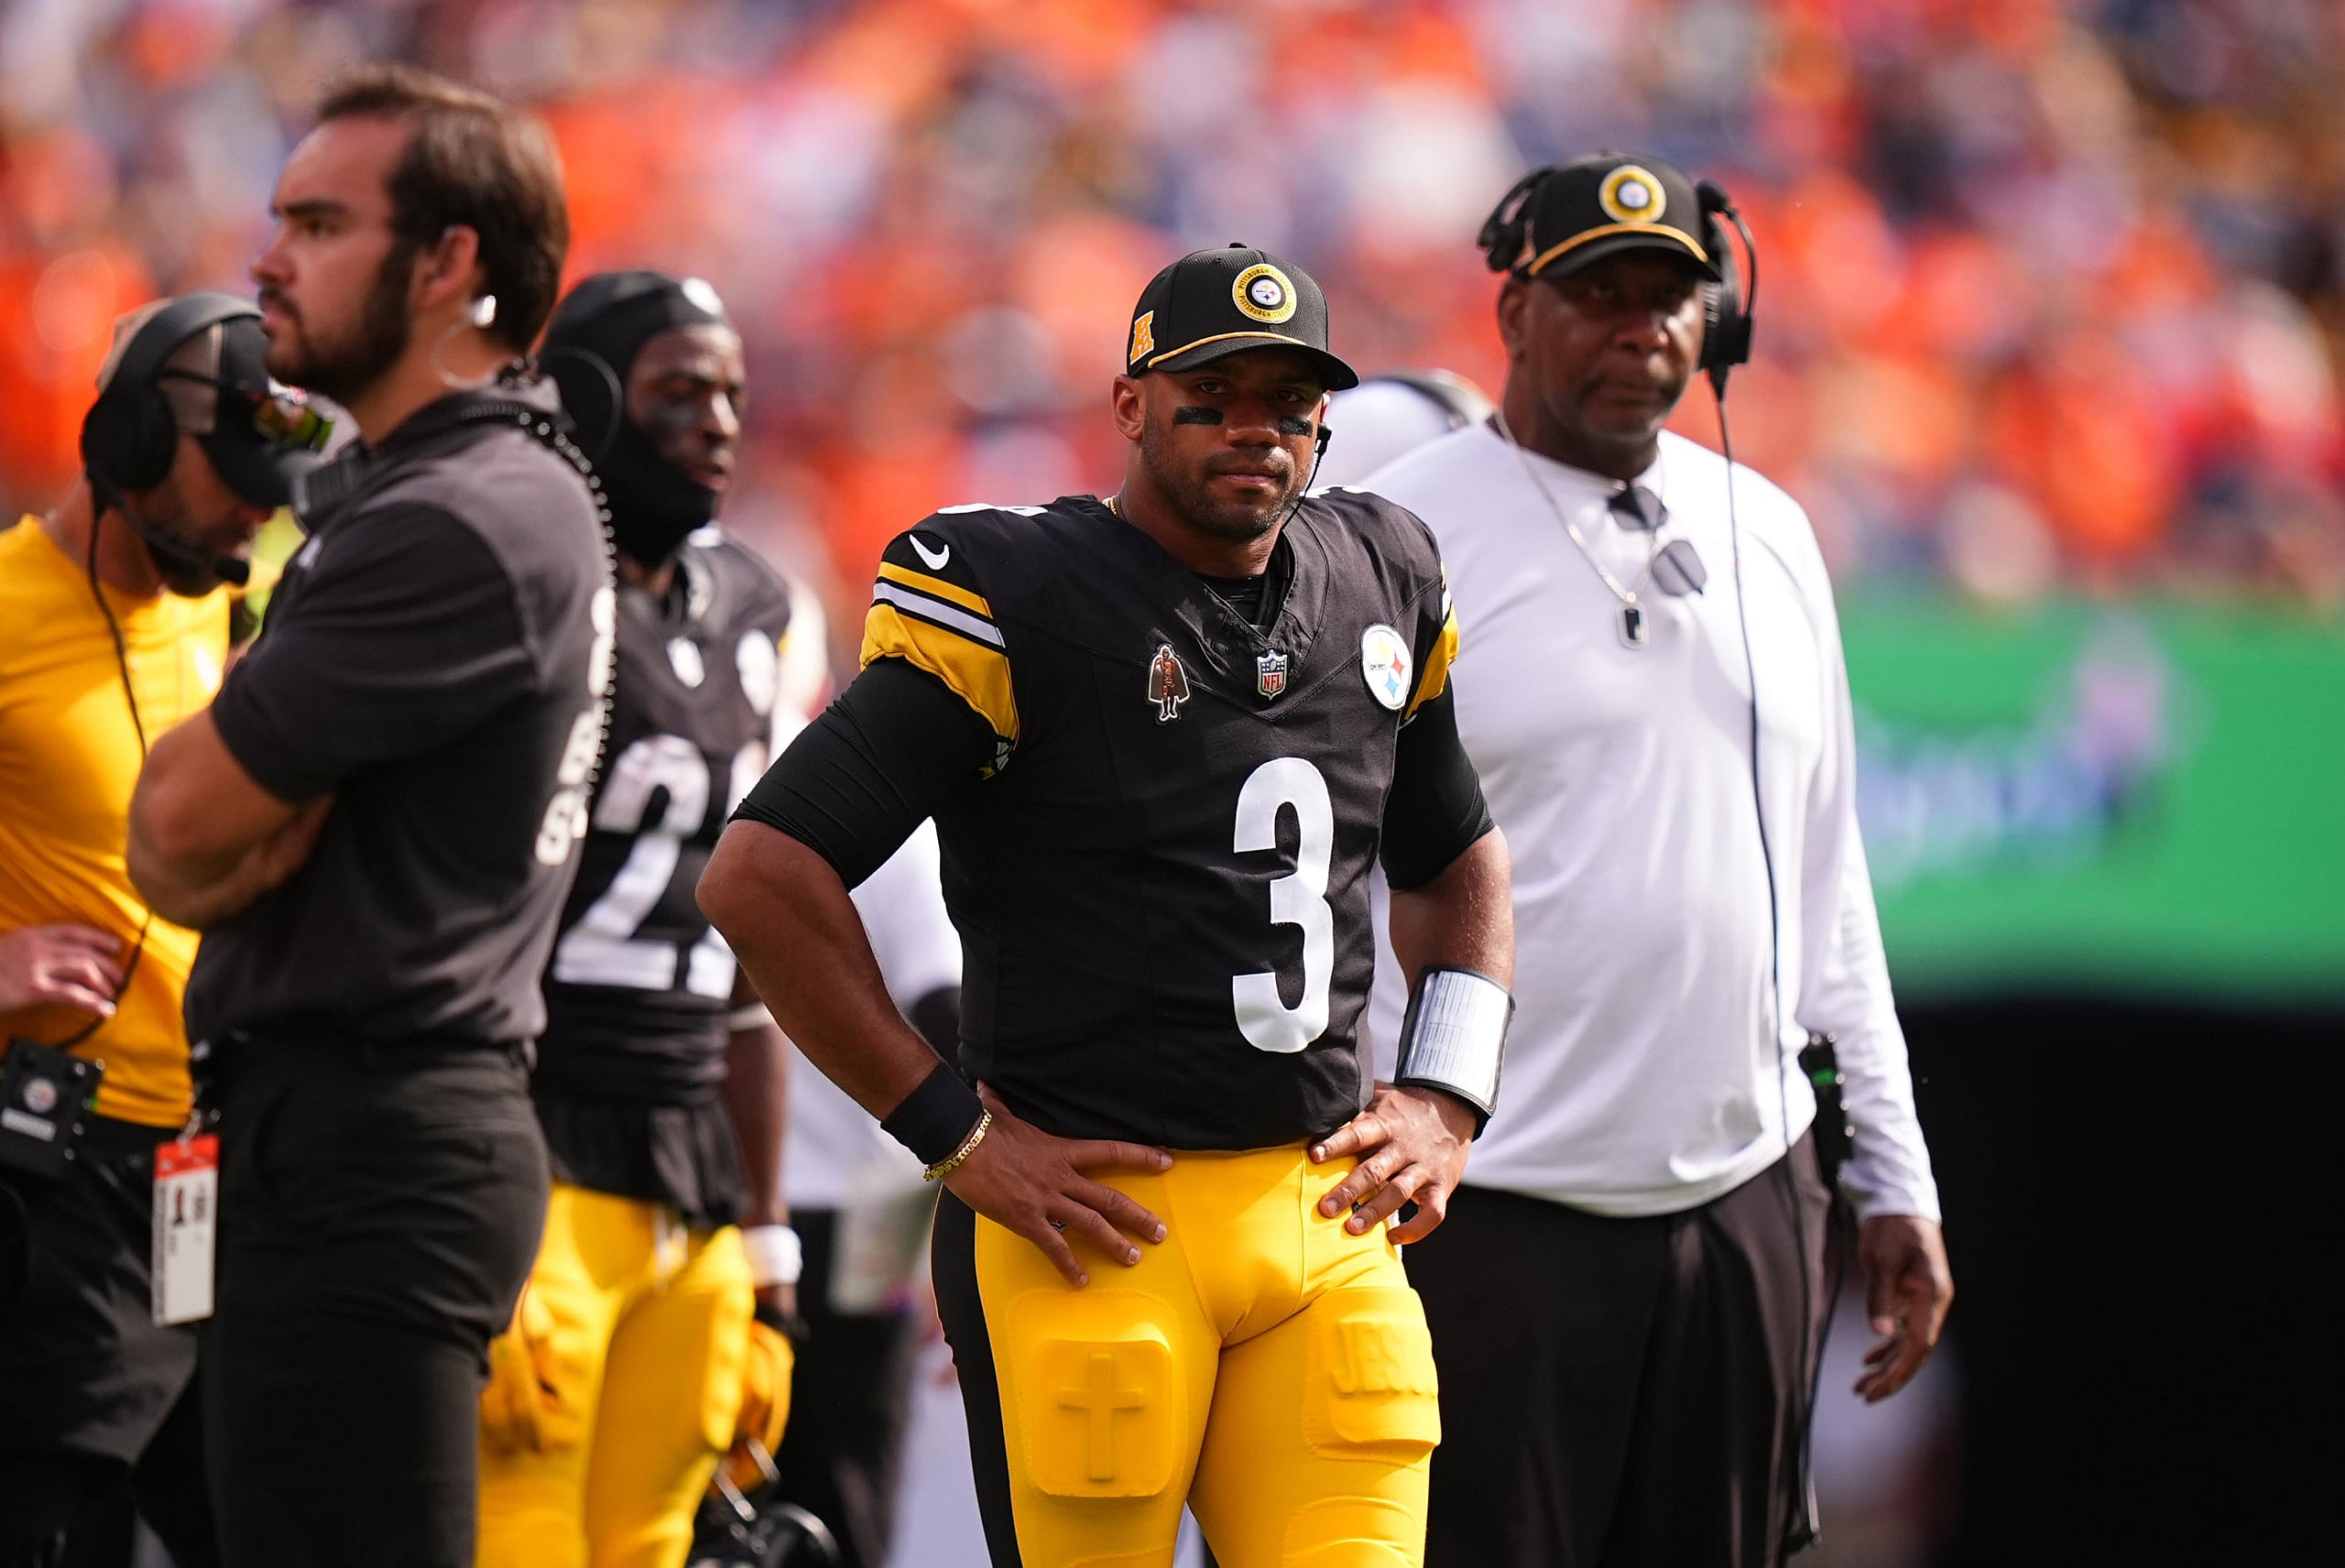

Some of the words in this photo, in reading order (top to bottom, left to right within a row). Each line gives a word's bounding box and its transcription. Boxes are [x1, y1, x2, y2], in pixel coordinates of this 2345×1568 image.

[1238, 267, 1270, 289] PITTSBURGH
[1238, 295, 1271, 317] PITTSBURGH
[1263, 673, 1282, 691] NFL
[1232, 757, 1335, 1053] 3
